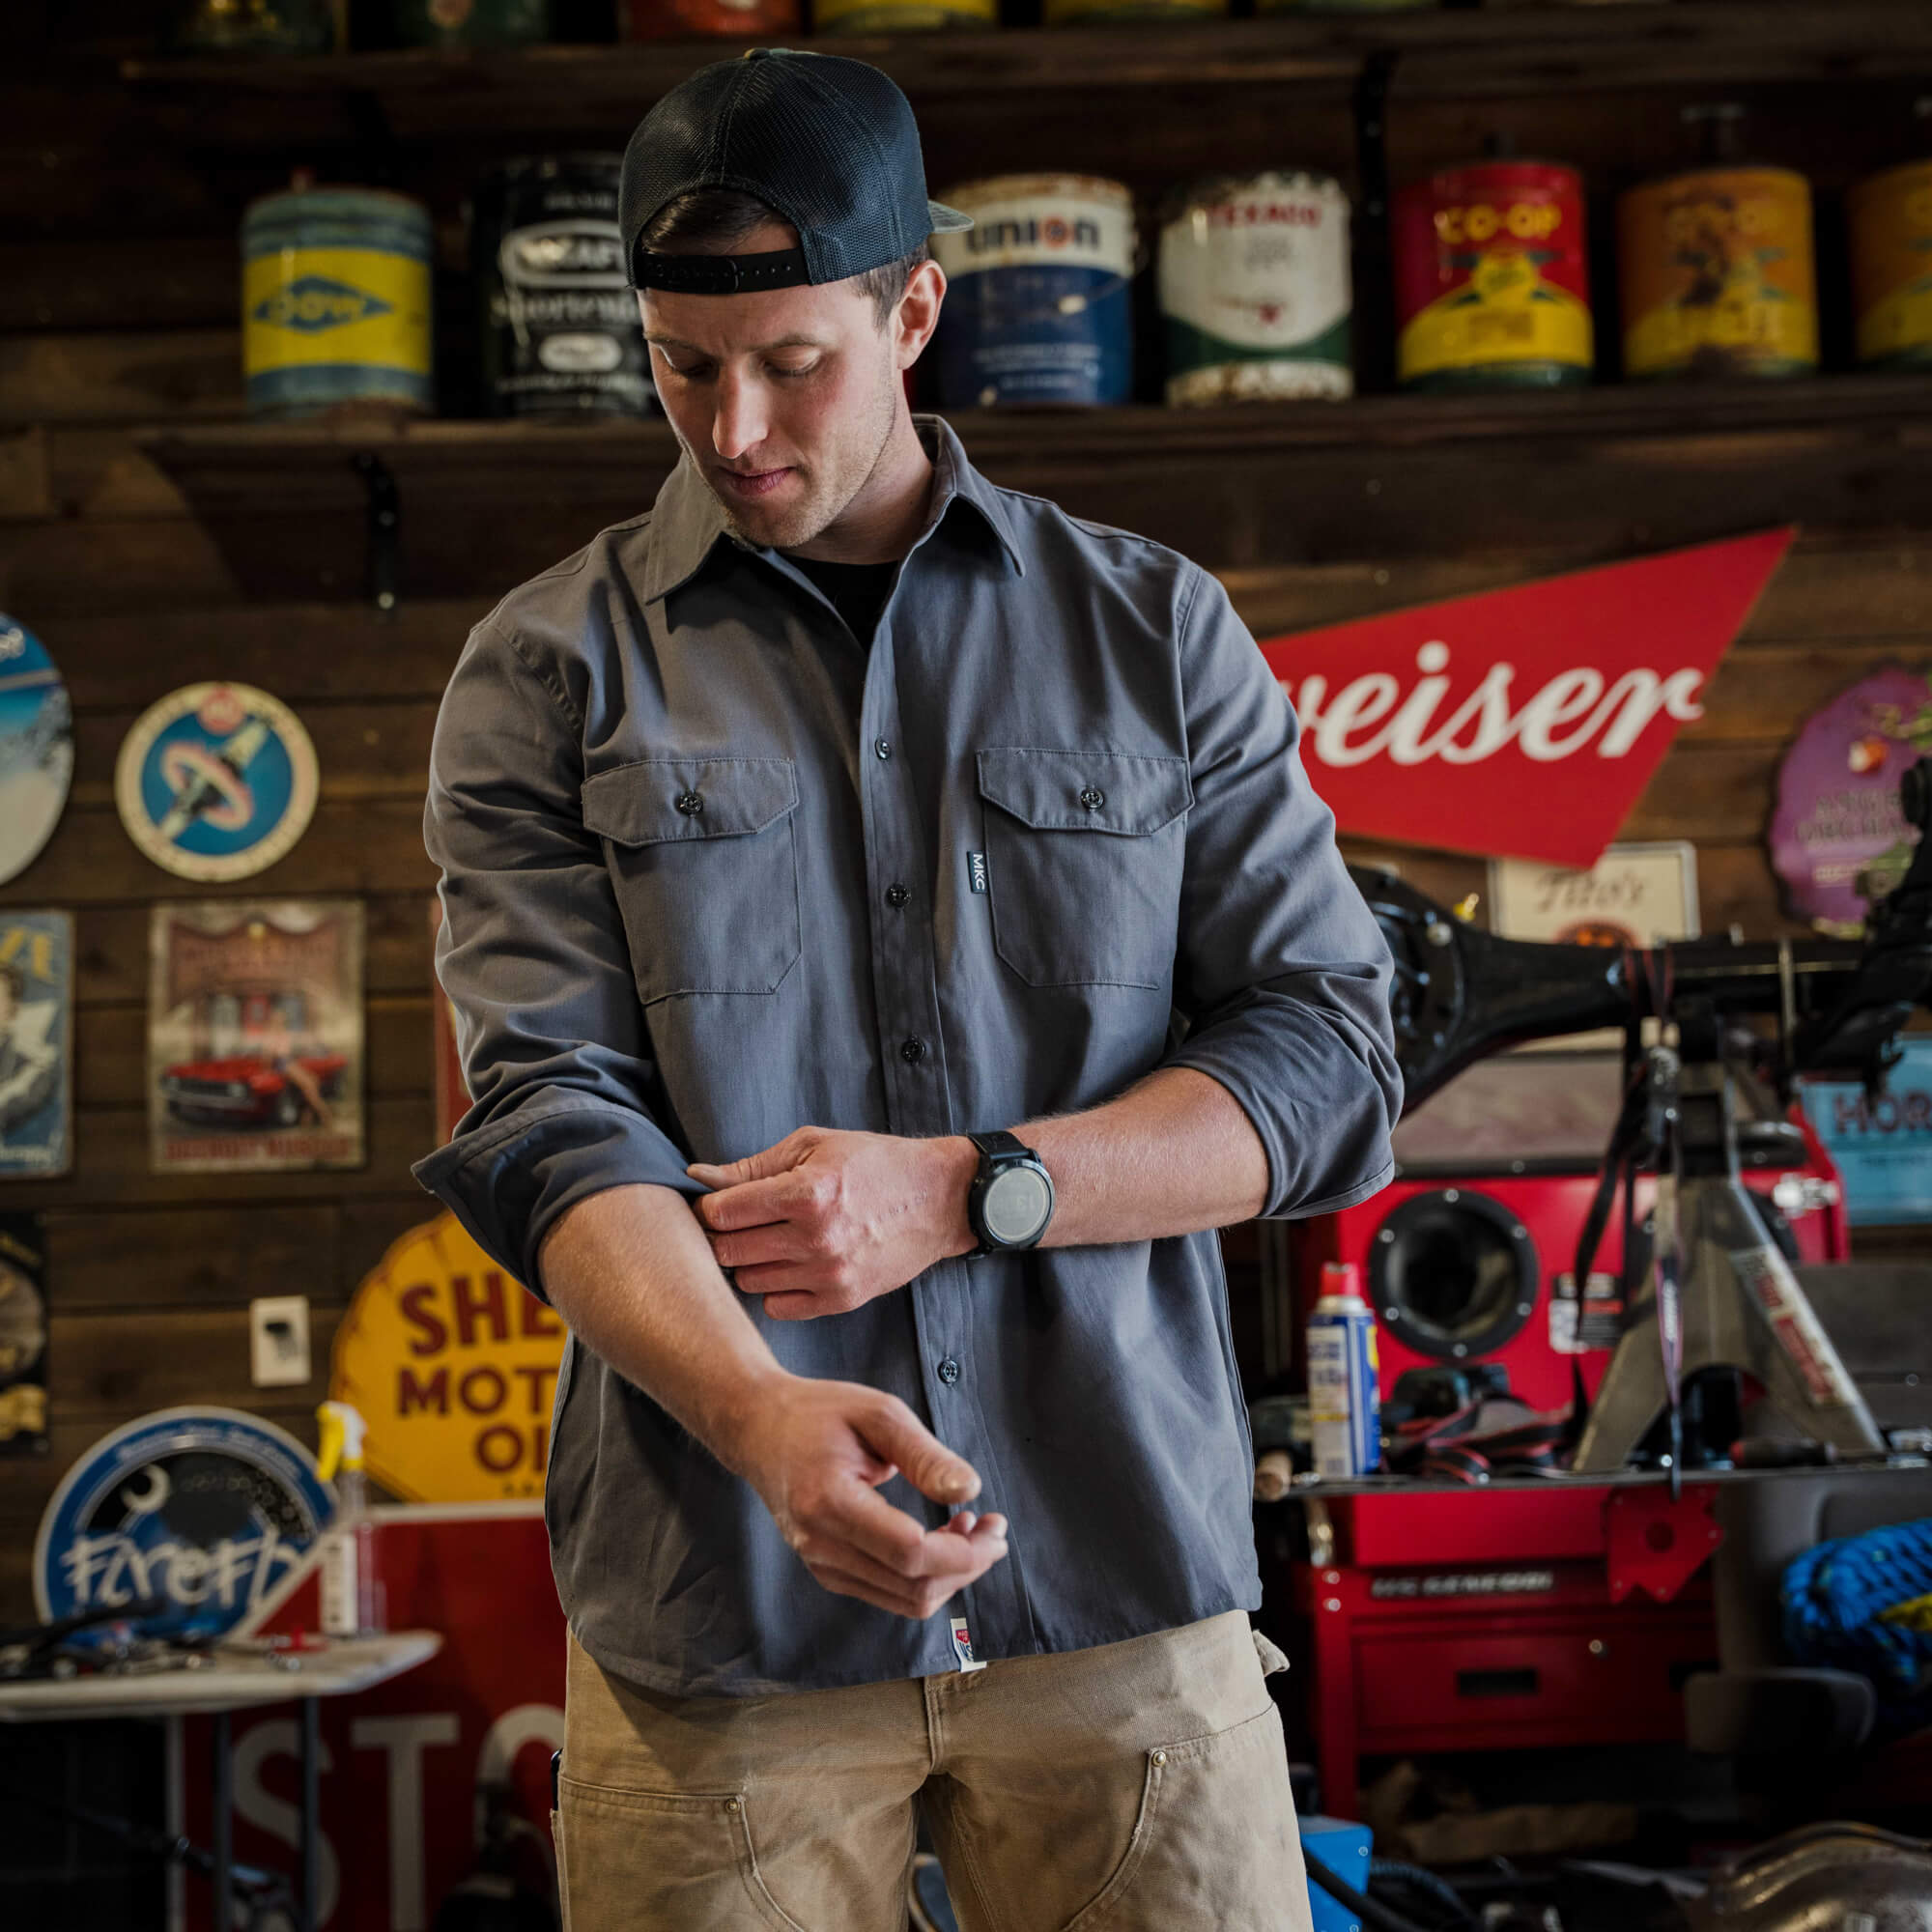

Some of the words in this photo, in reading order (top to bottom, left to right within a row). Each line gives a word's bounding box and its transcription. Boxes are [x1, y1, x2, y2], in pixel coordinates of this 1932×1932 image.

[966, 213, 1100, 253] union
[1435, 203, 1562, 243] CO-OP
[1280, 639, 1705, 769] eiser
[973, 853, 985, 890] MKC
[398, 1270, 560, 1357] SHE
[398, 1365, 560, 1418] MOT
[474, 1424, 548, 1474] OI
[232, 1703, 566, 1932] ST
